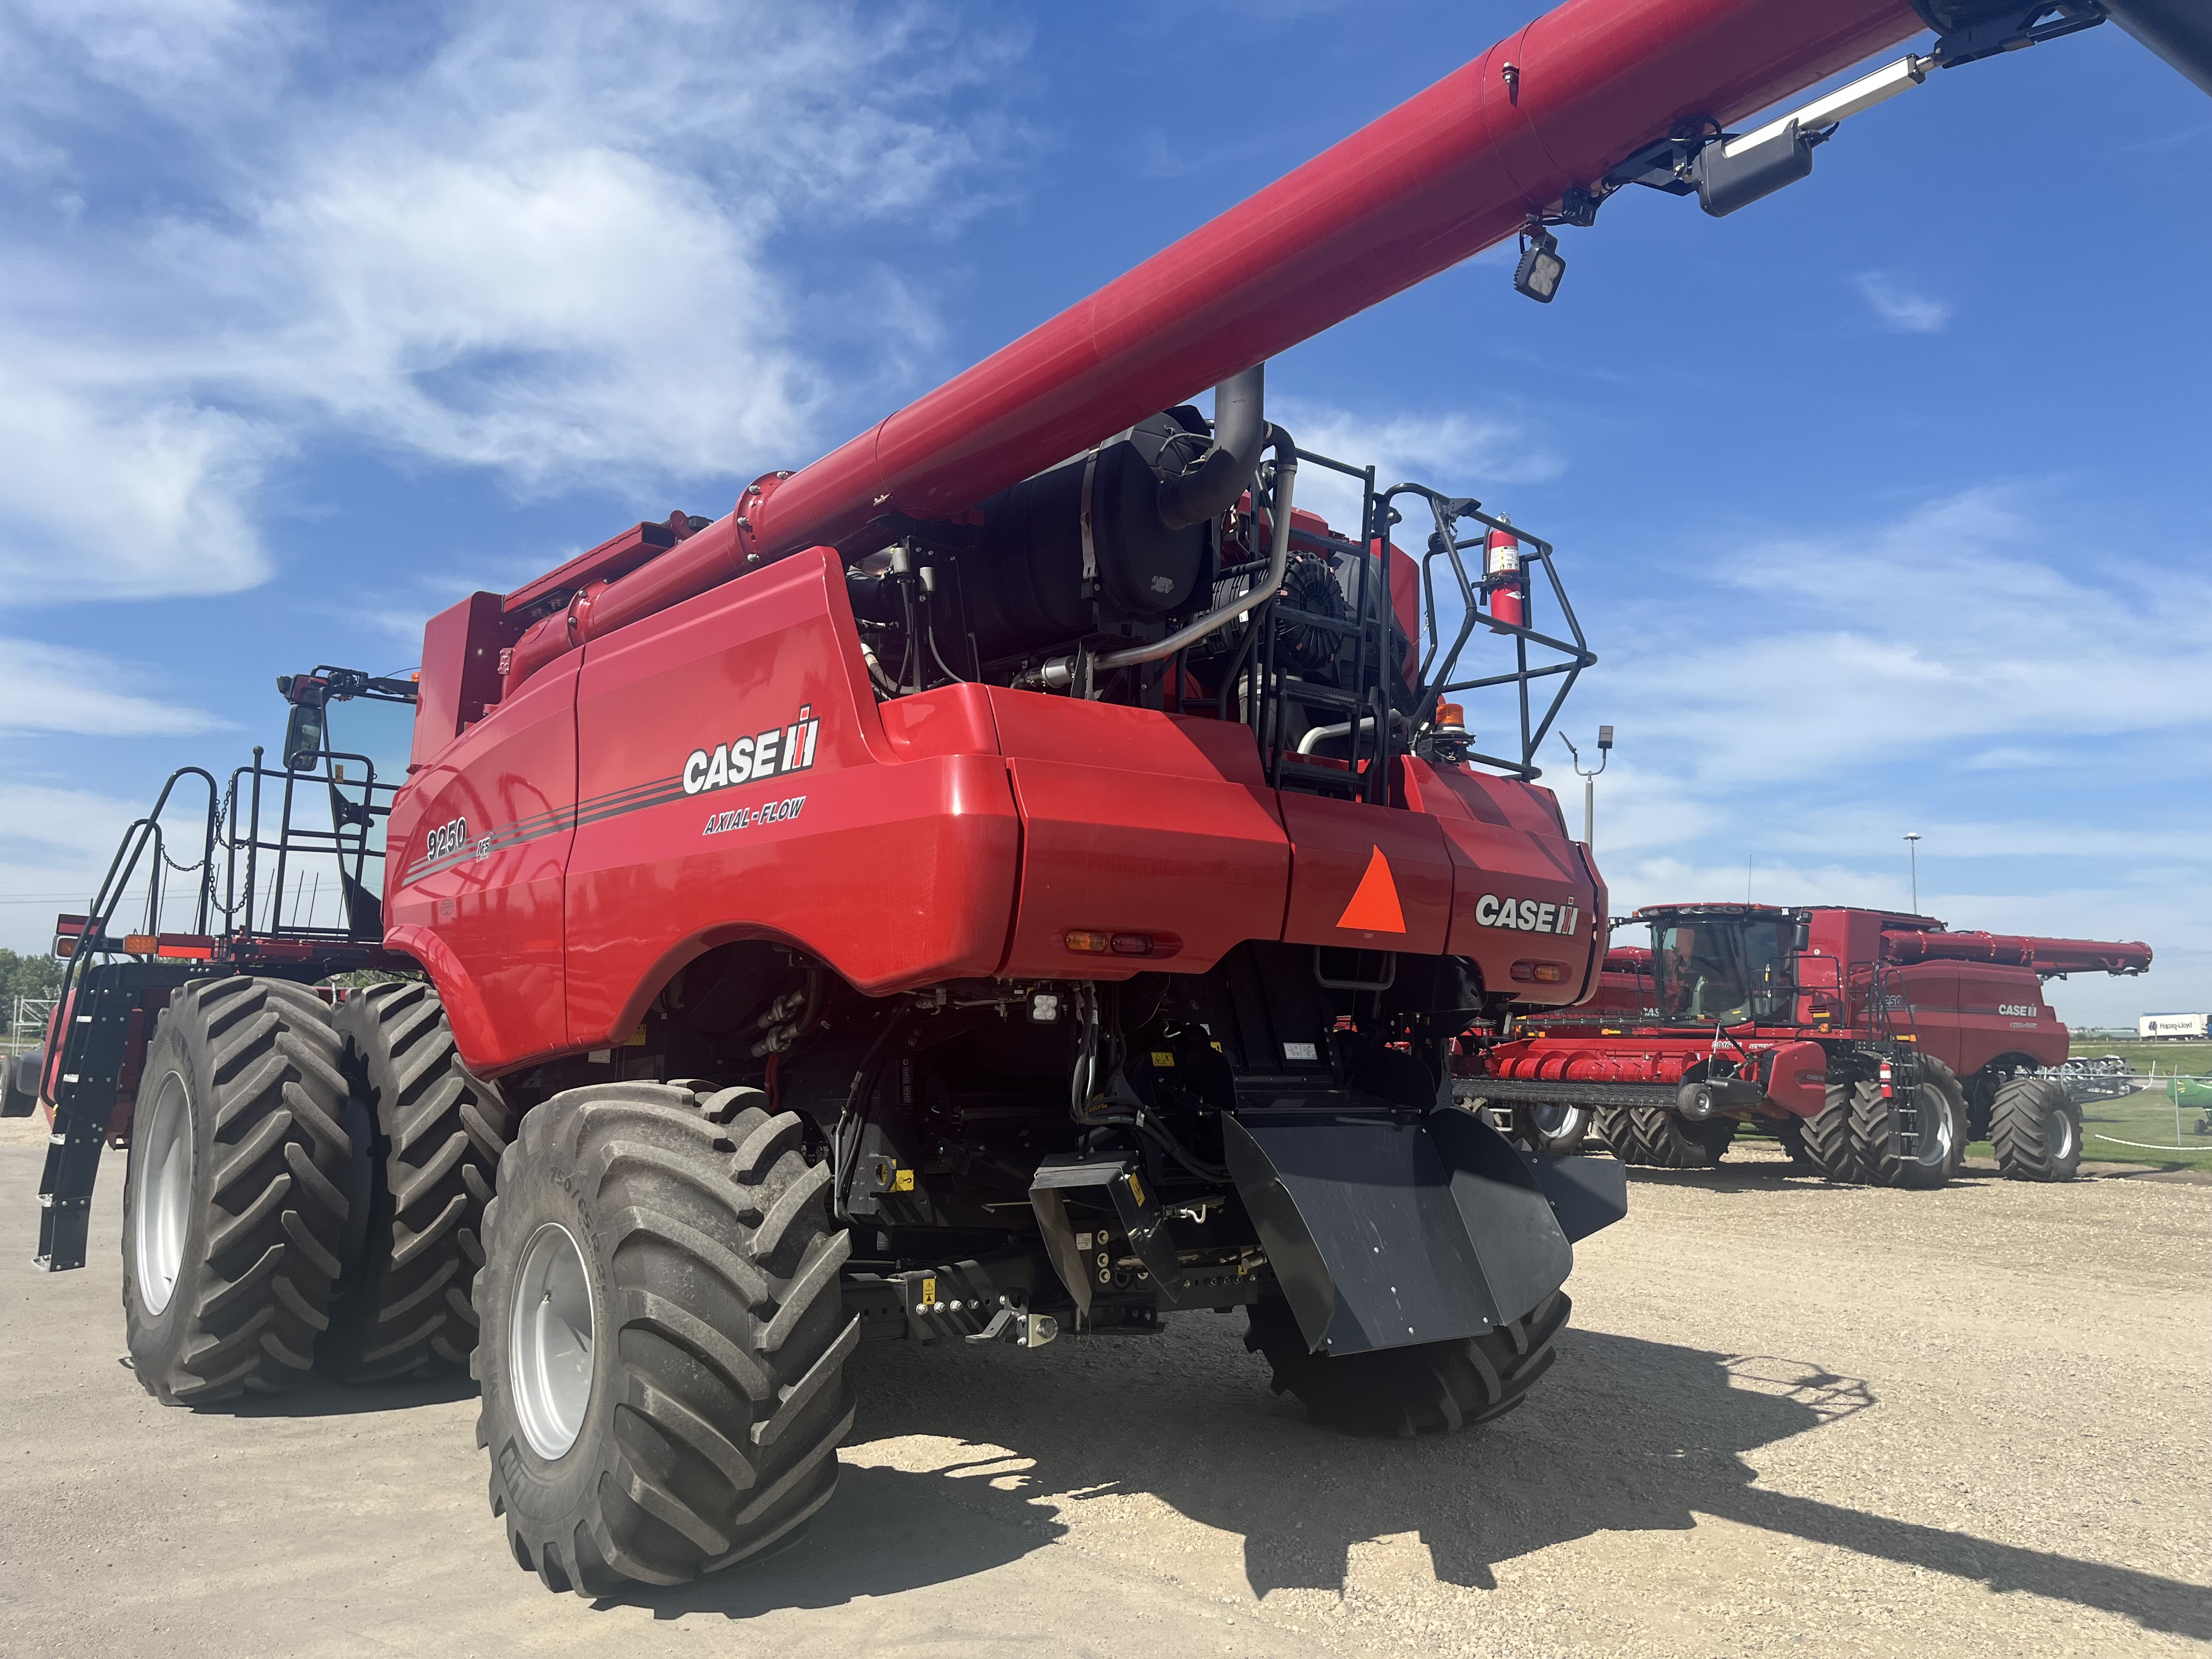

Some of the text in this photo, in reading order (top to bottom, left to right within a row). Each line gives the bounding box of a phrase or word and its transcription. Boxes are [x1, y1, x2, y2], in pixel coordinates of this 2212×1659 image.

[683, 730, 780, 794] CASE
[702, 795, 806, 836] AXIAL-FLOW
[427, 816, 466, 861] 9250
[1475, 894, 1555, 933] CASE
[1878, 995, 1902, 1006] 250
[1999, 1004, 2027, 1017] CASE
[2160, 1021, 2192, 1030] Hapag-Lloyd
